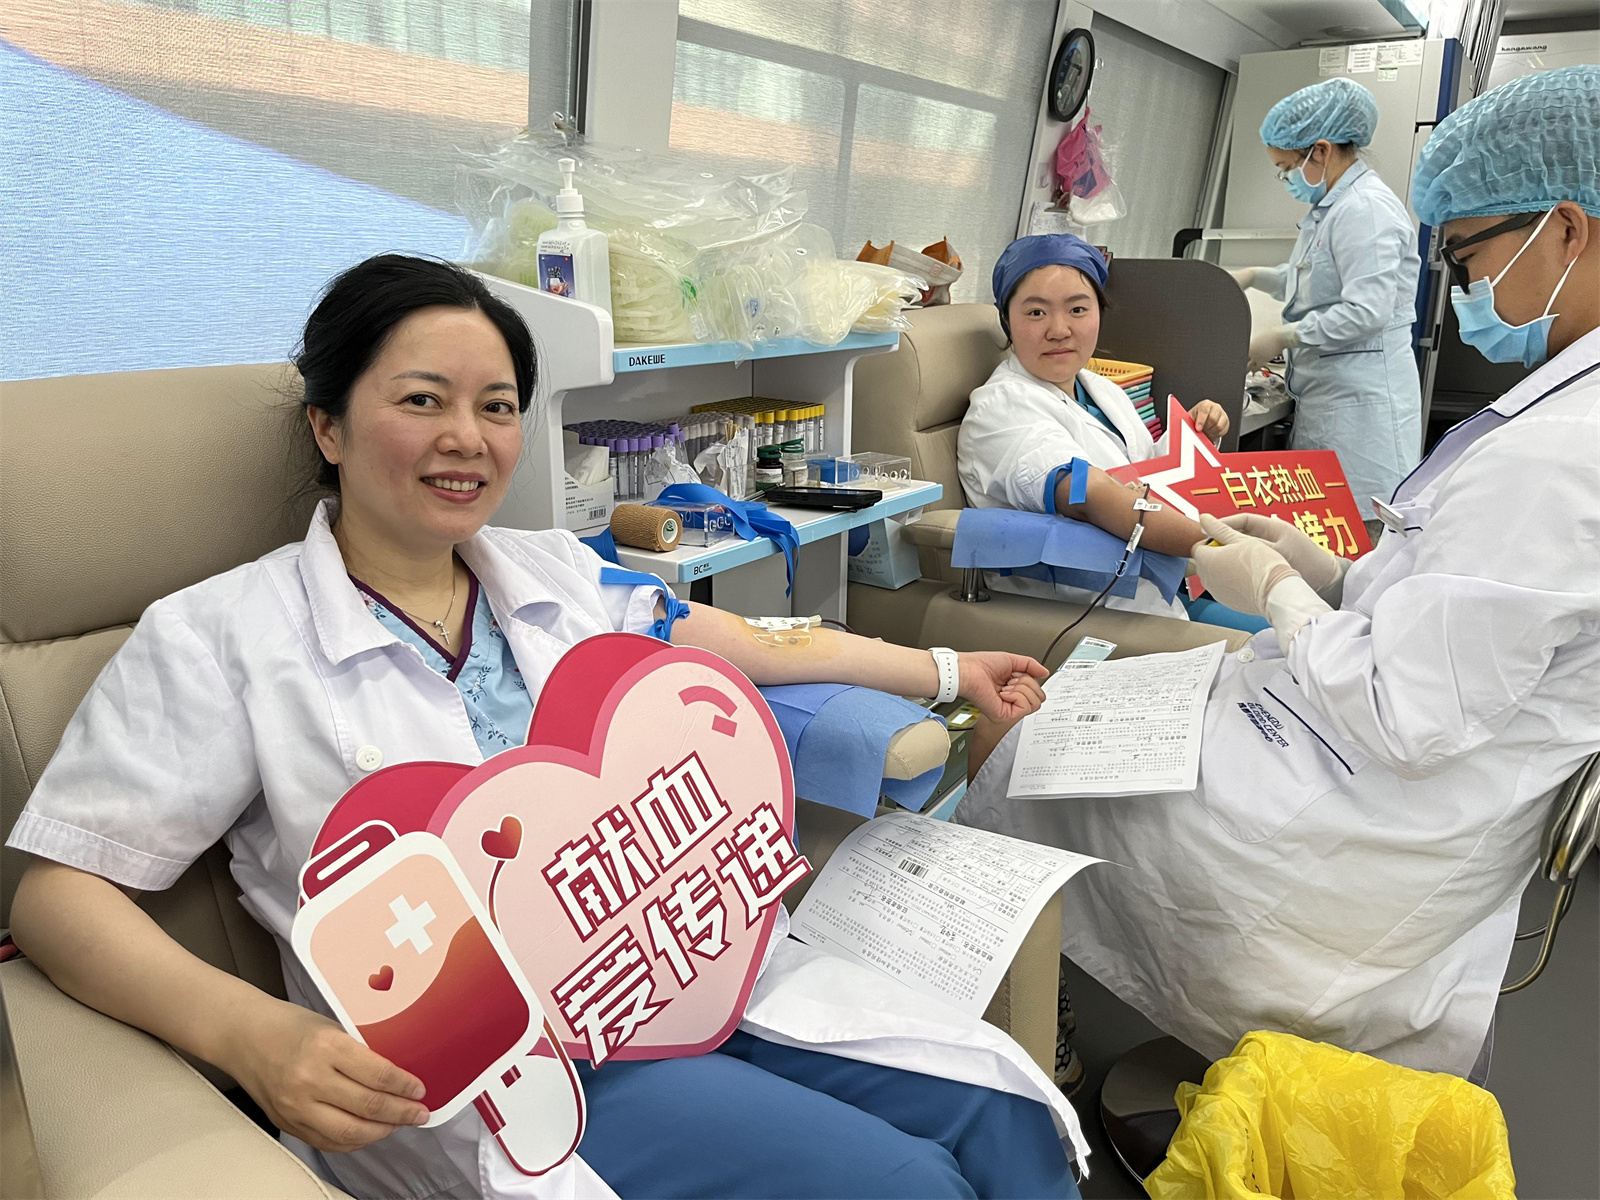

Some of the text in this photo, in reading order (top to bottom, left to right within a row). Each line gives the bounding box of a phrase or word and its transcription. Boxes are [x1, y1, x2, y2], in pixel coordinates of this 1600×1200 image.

[628, 353, 666, 367] DAKEWE
[1220, 463, 1327, 509] 白衣热血
[1269, 508, 1359, 557] 接力
[1254, 702, 1284, 730] CHENGDU
[1263, 723, 1290, 748] CENTER
[541, 750, 732, 943] 献血
[550, 802, 812, 1070] 爱传递
